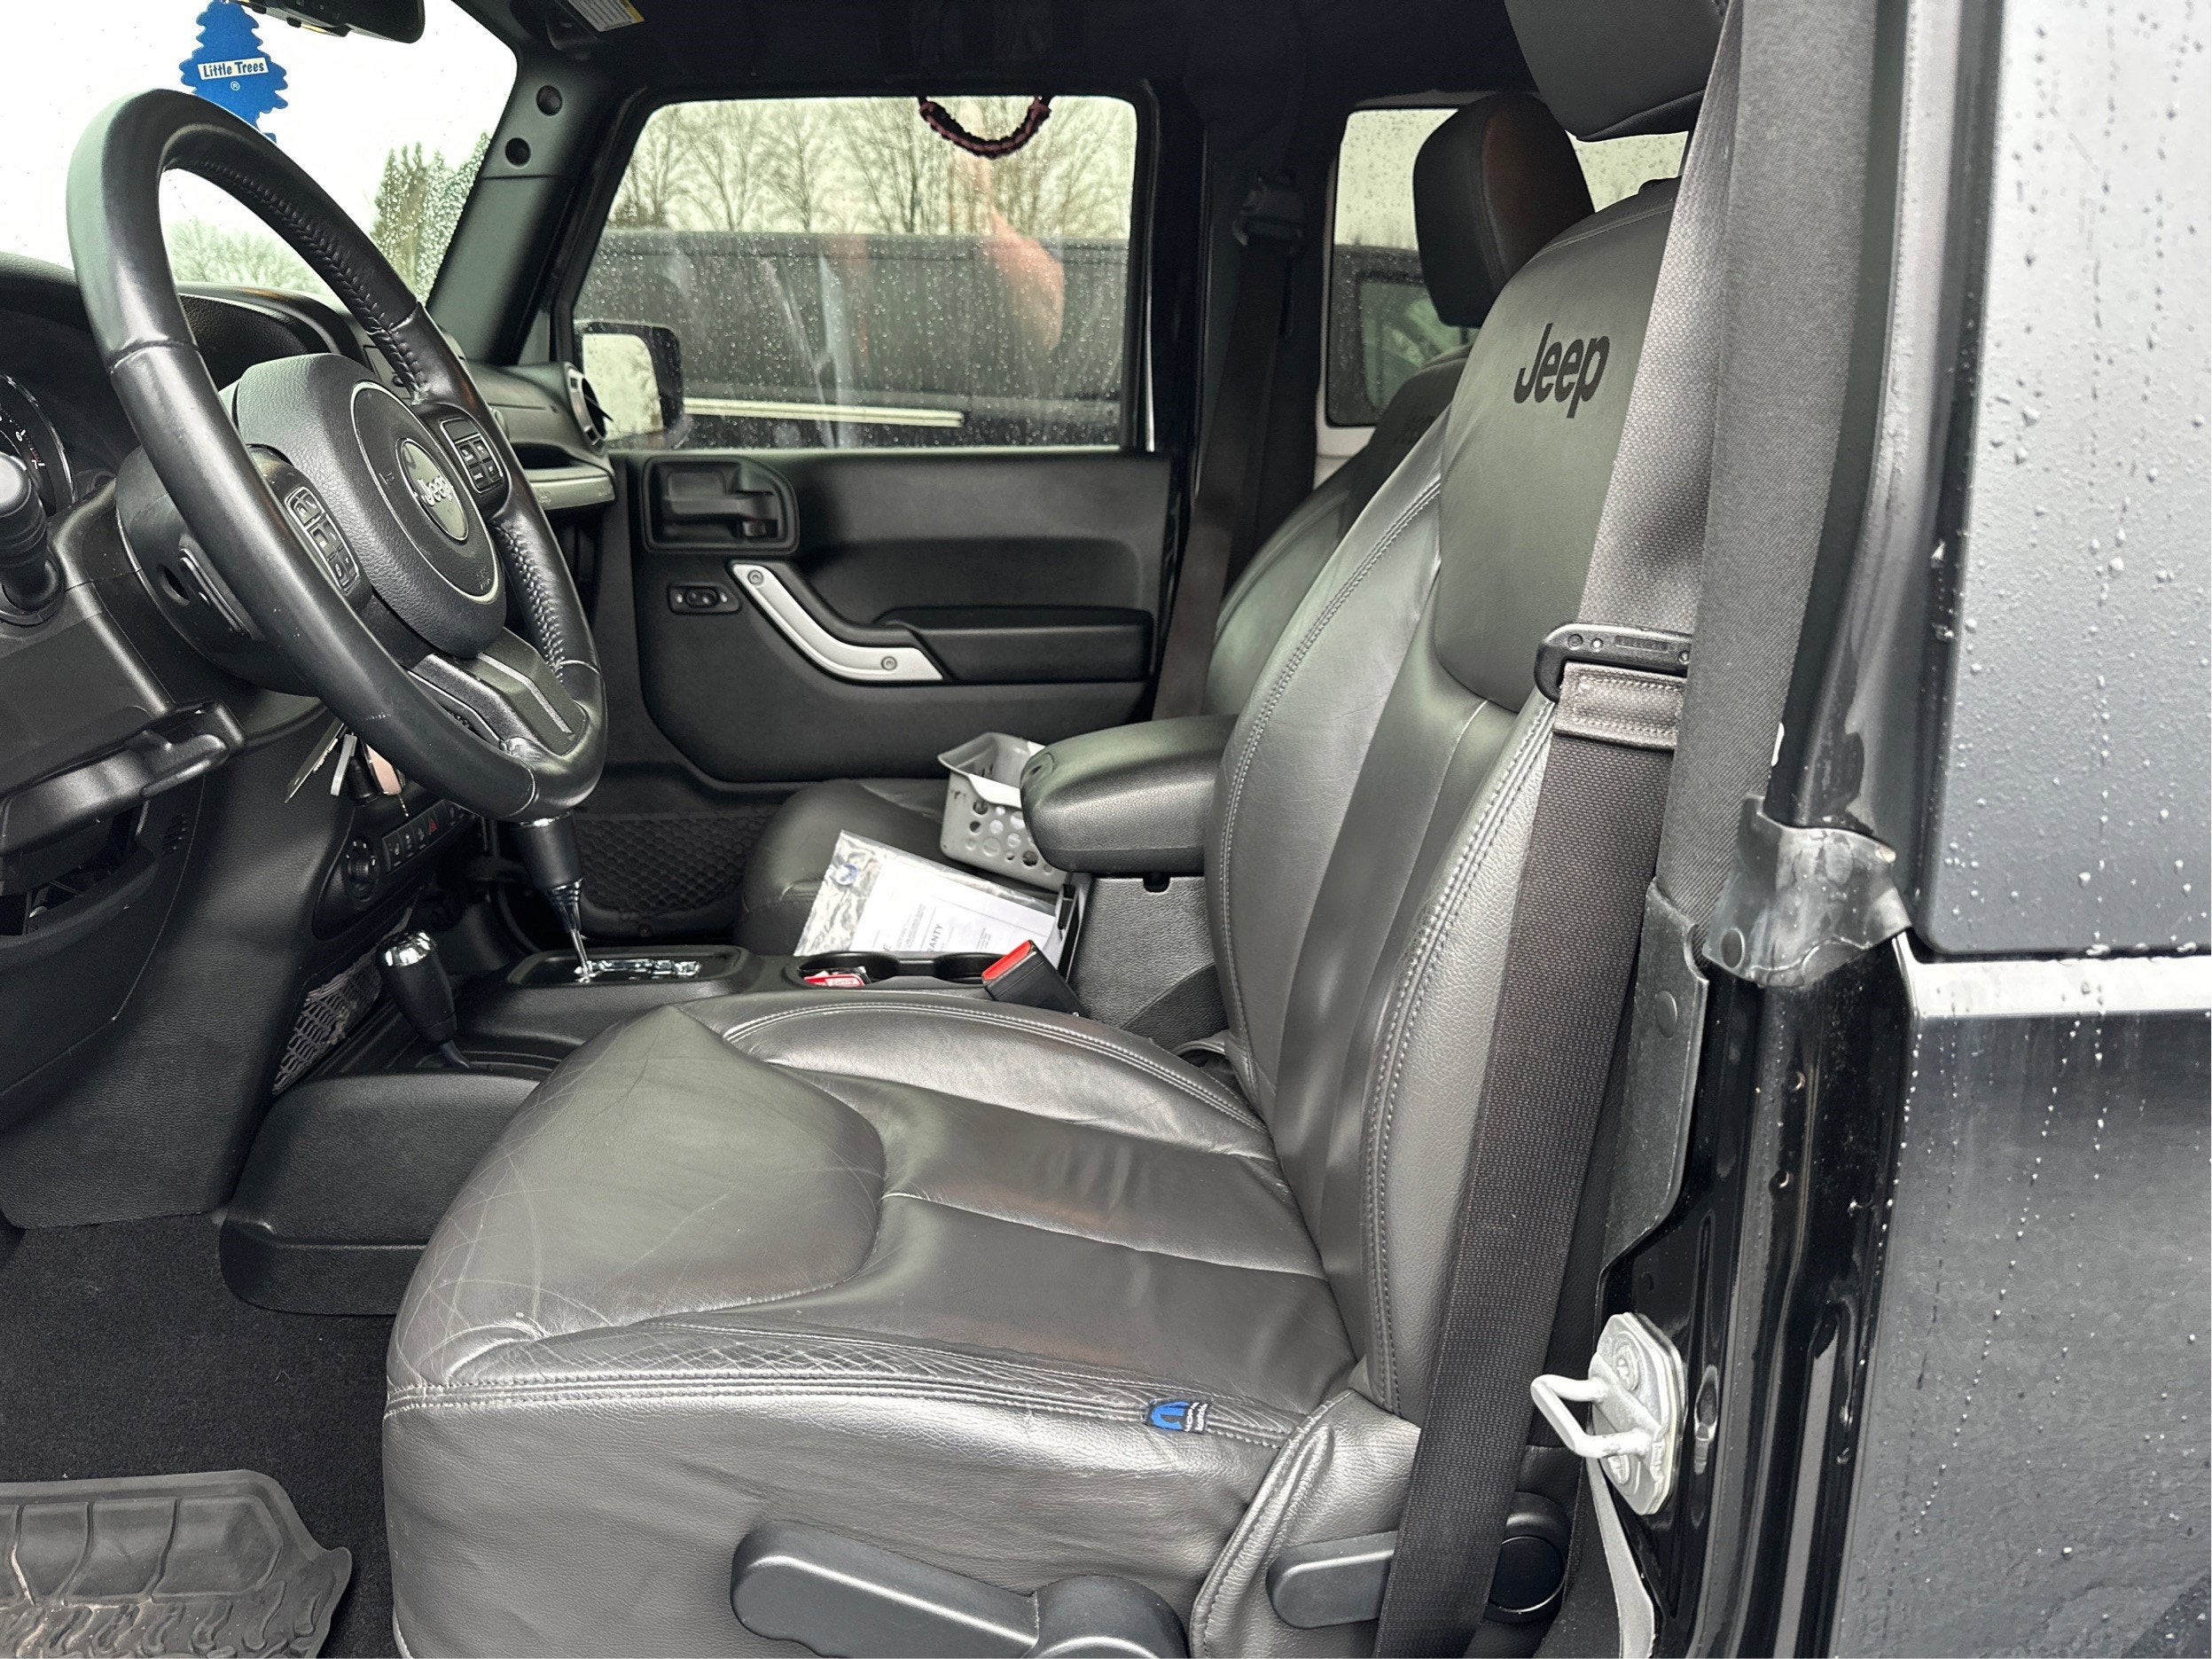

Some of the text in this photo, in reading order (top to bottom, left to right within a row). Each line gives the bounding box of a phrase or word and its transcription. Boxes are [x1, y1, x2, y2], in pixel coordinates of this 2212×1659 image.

[202, 60, 265, 77] Little Trees
[1513, 322, 1610, 419] Jeep
[417, 475, 453, 506] Jeep
